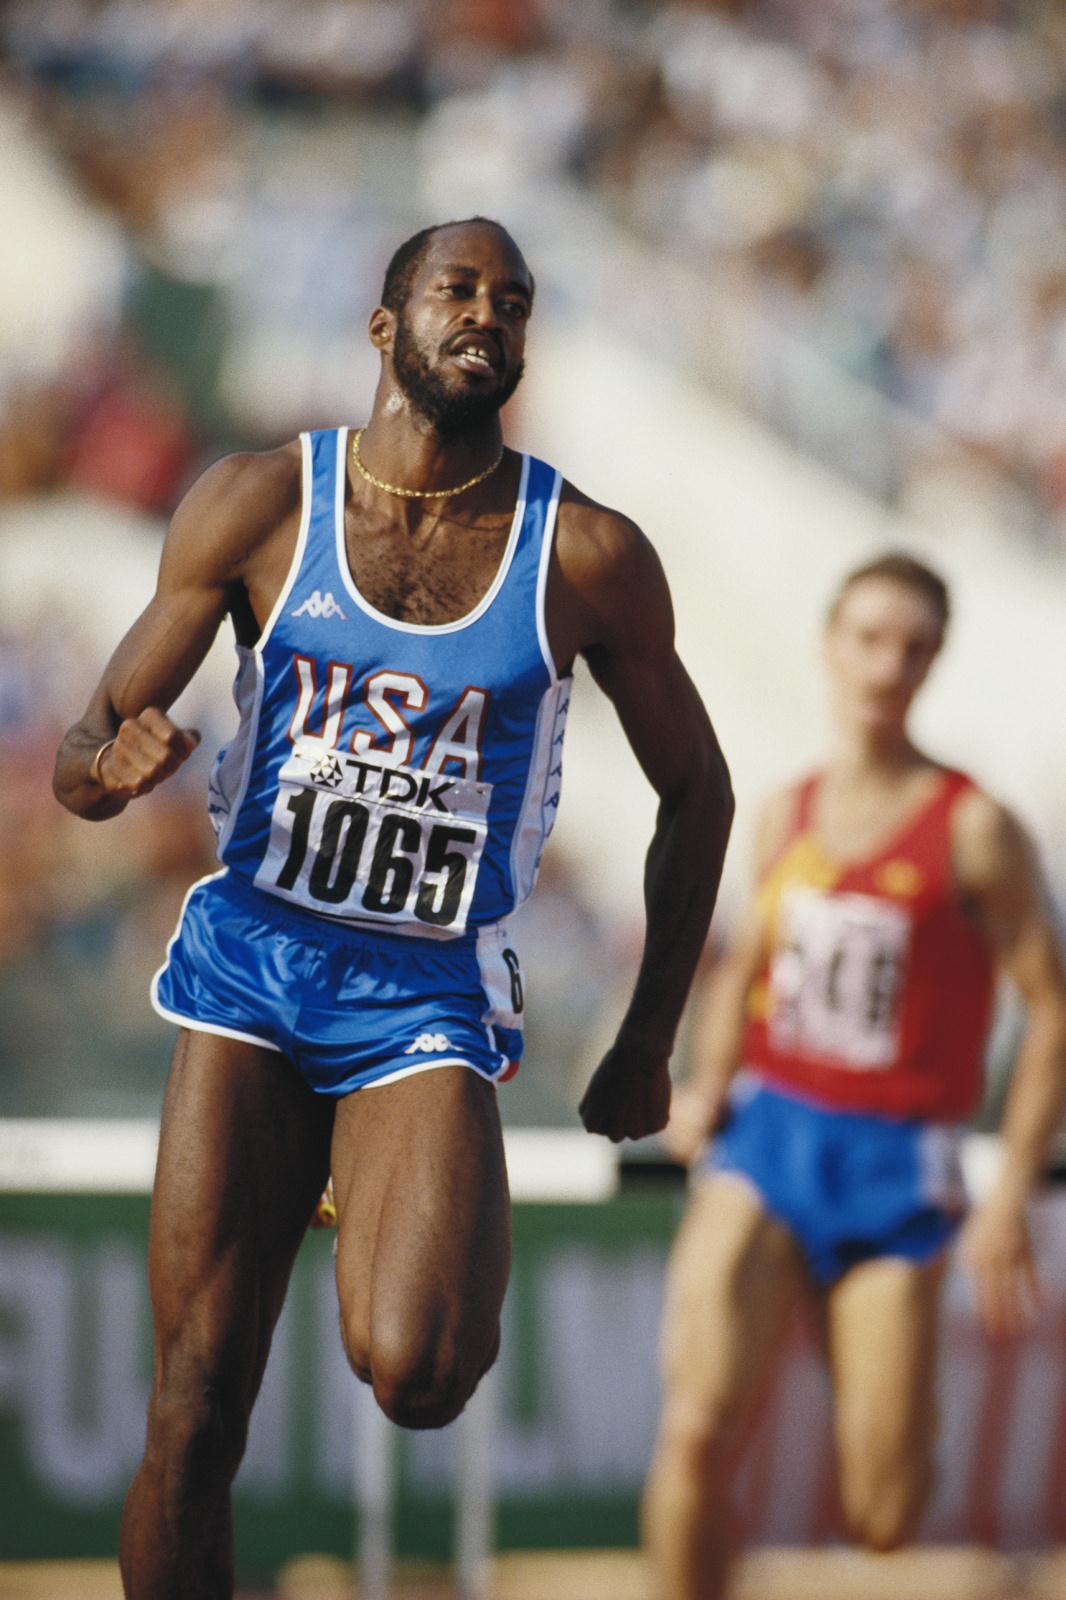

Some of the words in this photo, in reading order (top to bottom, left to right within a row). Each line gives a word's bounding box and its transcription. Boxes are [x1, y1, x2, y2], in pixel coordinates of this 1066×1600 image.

[288, 654, 490, 783] USA
[346, 759, 456, 813] TDK
[275, 787, 477, 926] 1065
[502, 948, 524, 1014] 6
